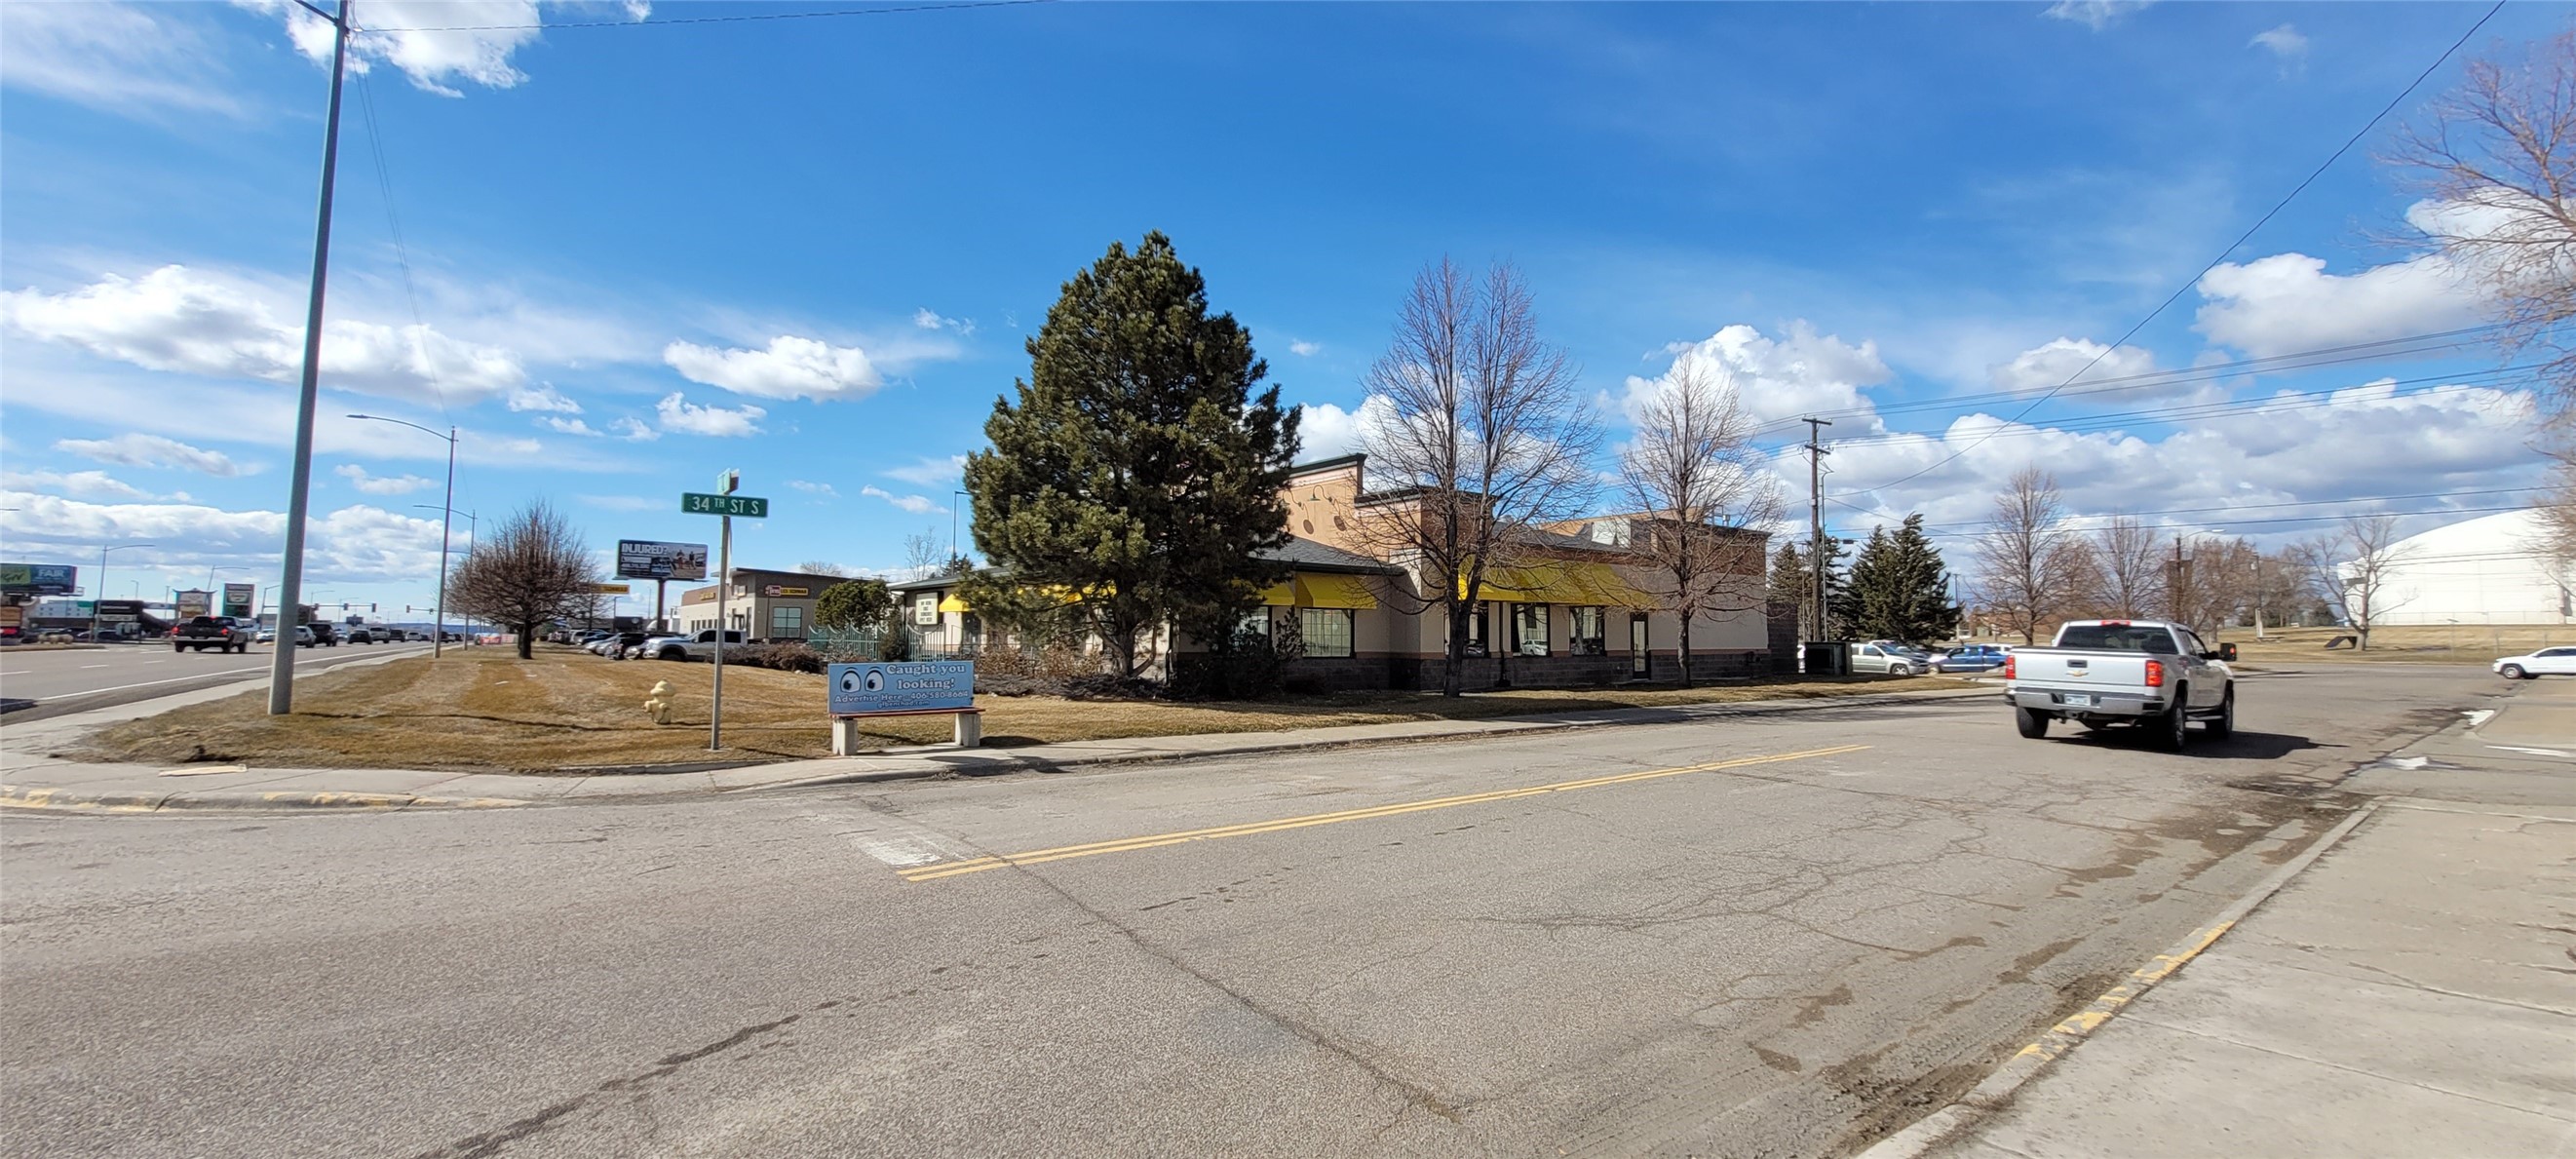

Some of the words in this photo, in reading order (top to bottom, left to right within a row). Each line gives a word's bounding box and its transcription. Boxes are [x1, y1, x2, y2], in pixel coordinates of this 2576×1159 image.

[692, 496, 710, 511] 34
[730, 499, 746, 514] ST
[750, 500, 759, 515] S
[621, 543, 668, 555] INJURED?
[886, 664, 937, 676] Caught
[941, 665, 966, 675] you
[898, 677, 955, 690] looking!
[834, 694, 878, 703] Advertise
